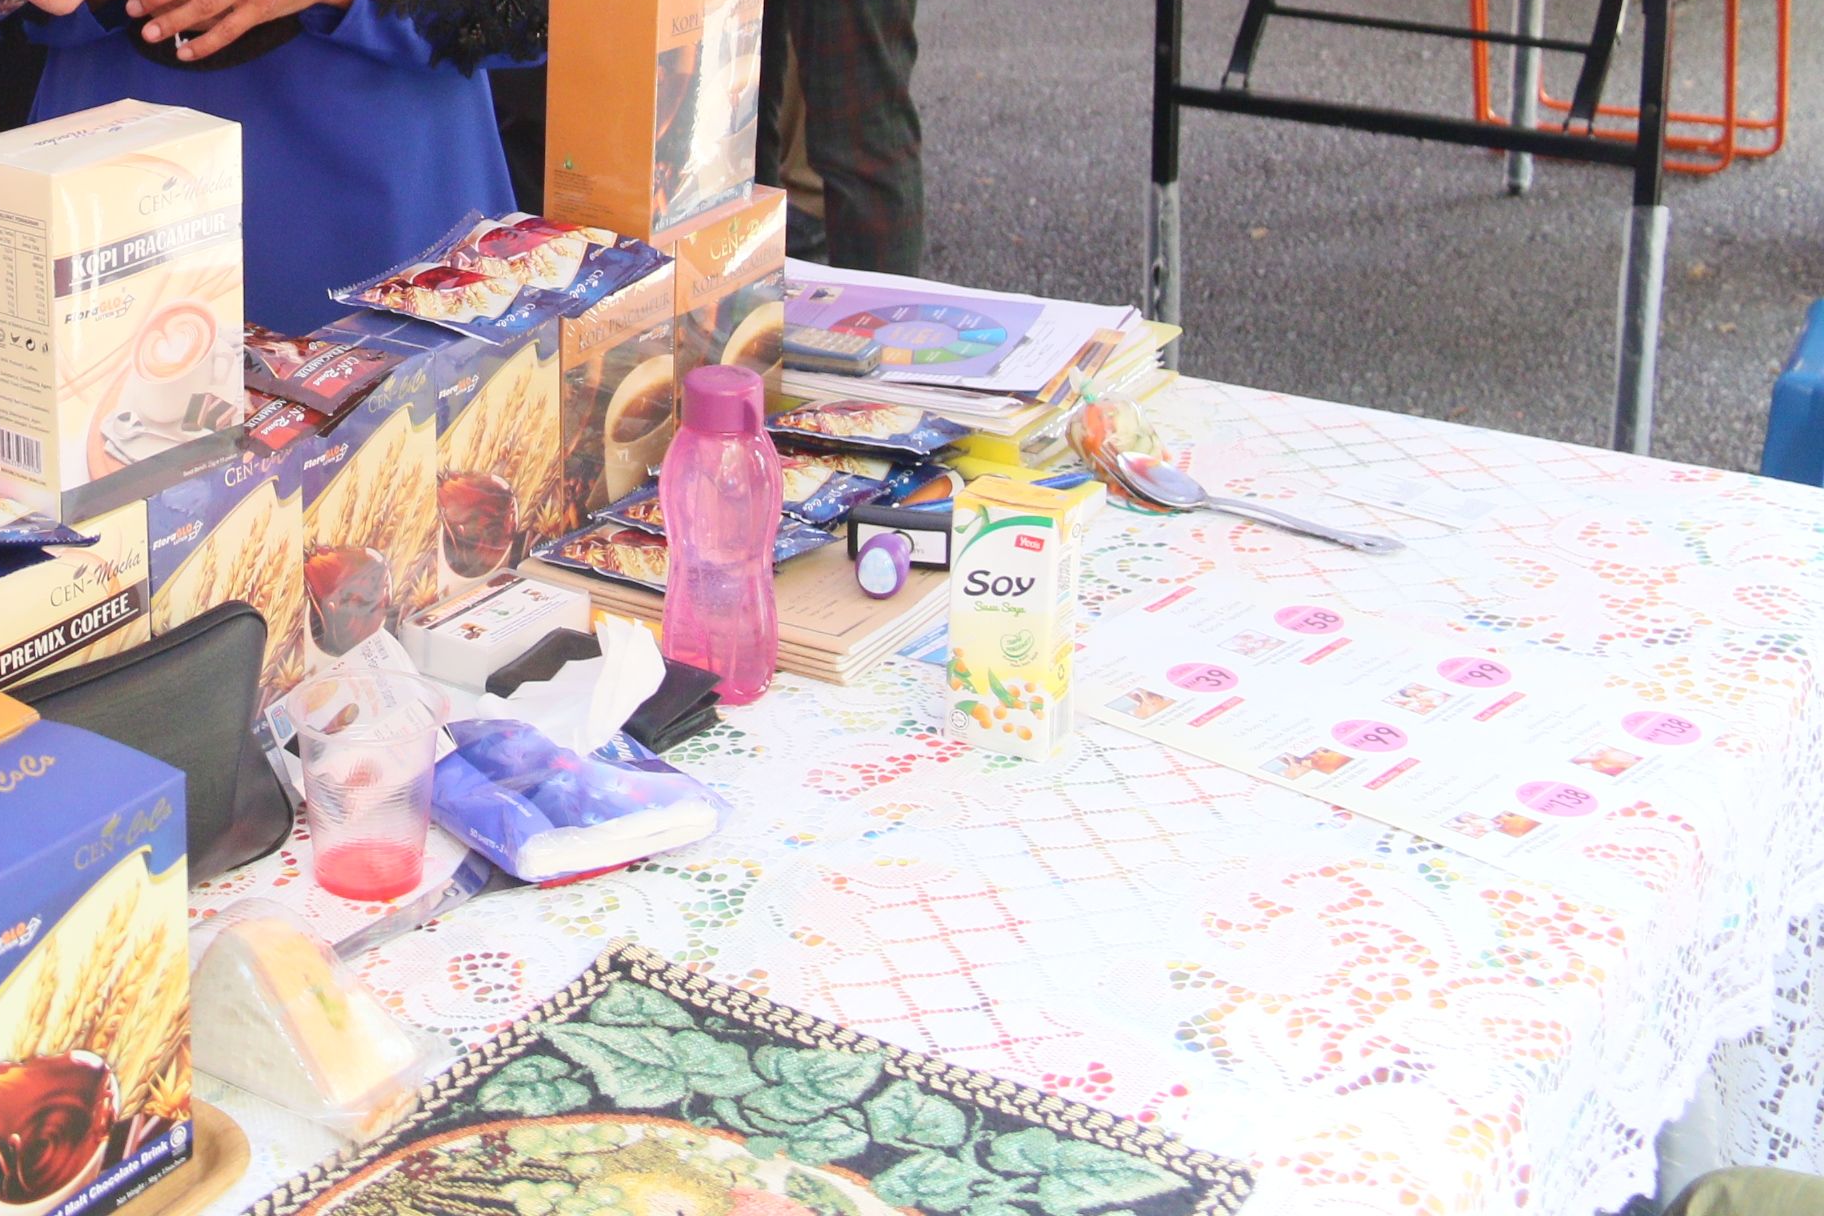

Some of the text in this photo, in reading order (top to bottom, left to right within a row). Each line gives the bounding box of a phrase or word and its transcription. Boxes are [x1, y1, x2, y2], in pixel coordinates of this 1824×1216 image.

[72, 213, 226, 279] KOPI PRACAMPUR
[303, 443, 342, 471] FloraGLO
[153, 521, 193, 551] FloraGLO
[51, 549, 141, 607] CEN-Mocha
[1304, 611, 1340, 630] 58
[0, 592, 130, 676] PREMIX COFFEE
[1195, 668, 1232, 687] 39
[1468, 662, 1504, 681] 99
[1364, 726, 1401, 745] 99
[1656, 718, 1693, 738] 138
[1551, 788, 1590, 809] 138
[64, 1141, 169, 1216] Malt Chocolate Drink
